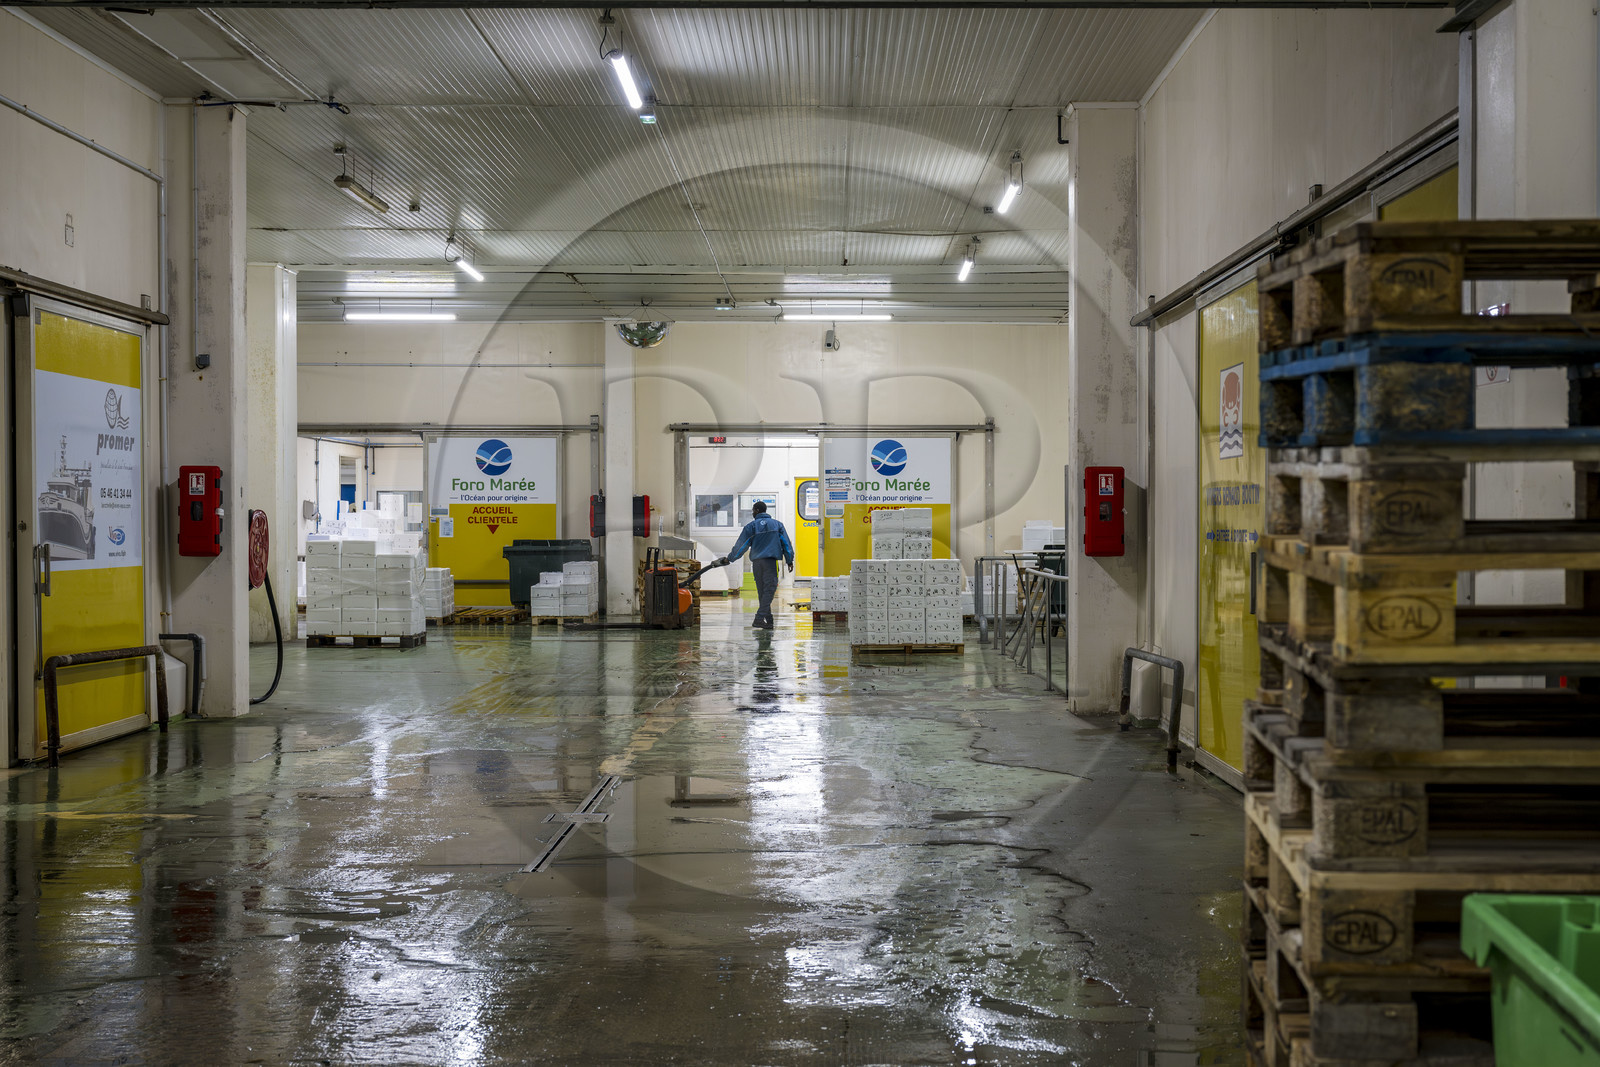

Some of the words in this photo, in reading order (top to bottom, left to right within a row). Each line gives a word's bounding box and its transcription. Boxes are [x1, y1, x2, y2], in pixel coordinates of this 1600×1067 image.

[96, 433, 135, 456] promer
[452, 478, 485, 491] Foro
[490, 477, 536, 491] Marée
[852, 478, 880, 491] oro
[885, 477, 931, 491] Marée
[100, 487, 106, 499] 05
[107, 487, 113, 499] 46
[113, 488, 119, 499] 41
[120, 488, 125, 499] 34
[126, 488, 132, 499] 44
[504, 494, 528, 502] origine
[899, 494, 923, 502] origine
[472, 506, 513, 514] ACCUEIL
[467, 516, 518, 524] CLIENTELE
[1378, 604, 1430, 631] EPAL
